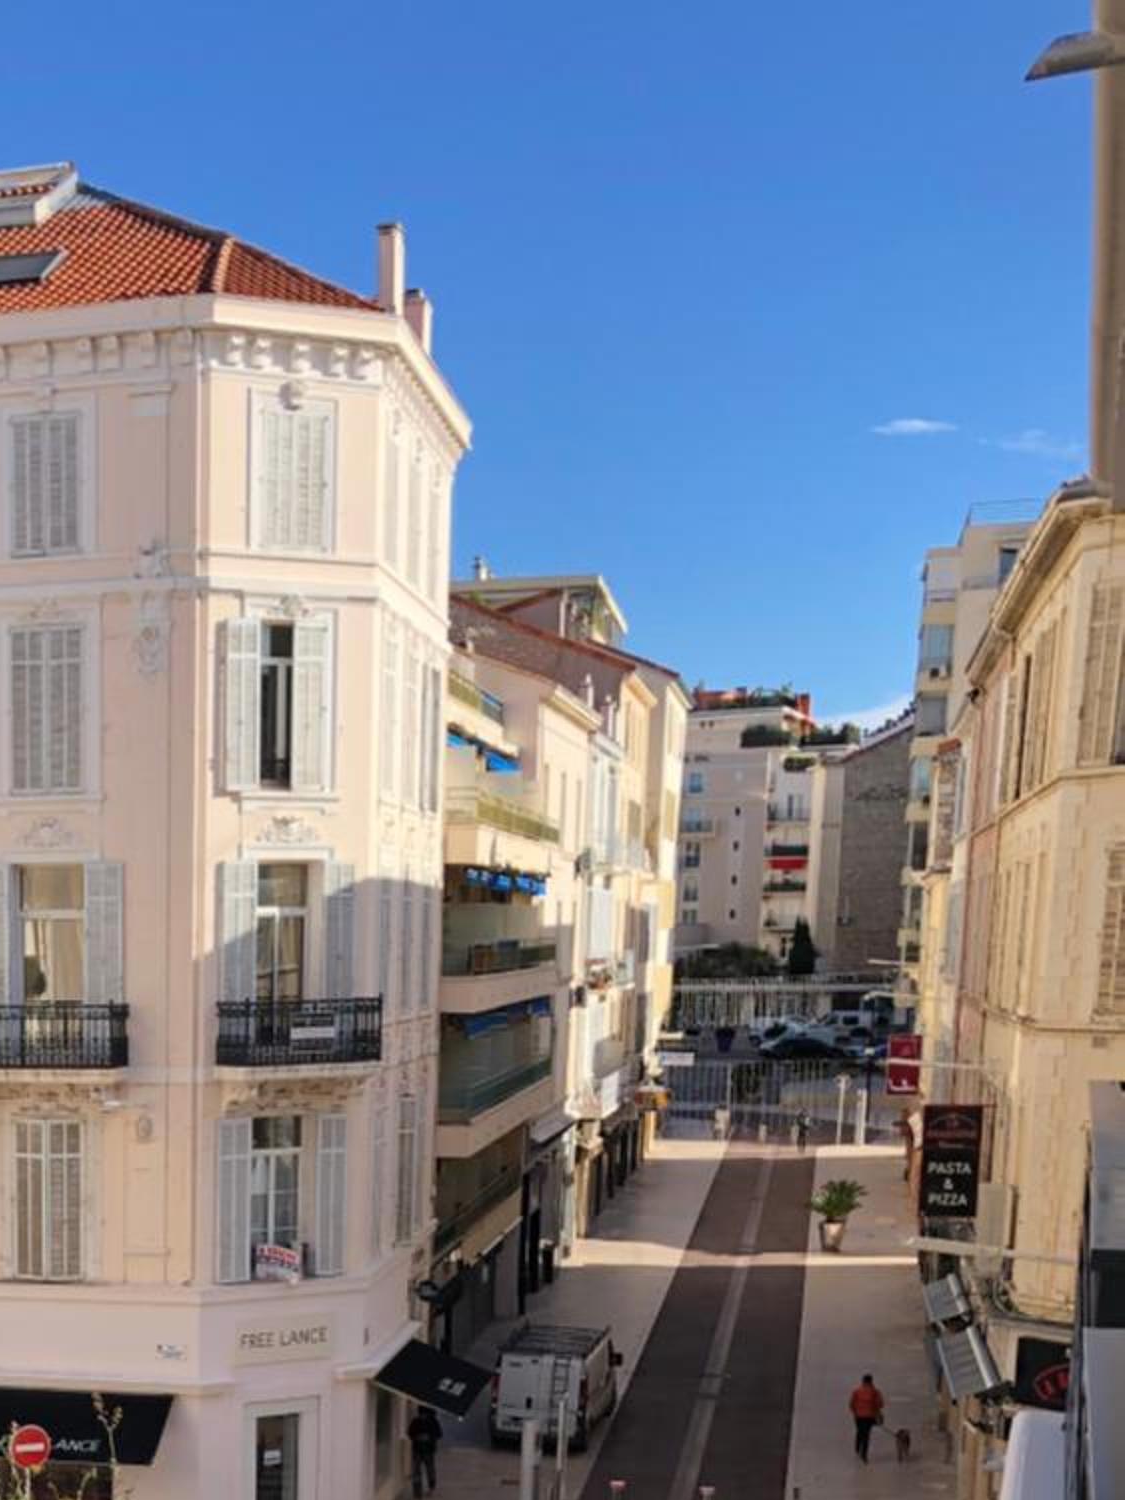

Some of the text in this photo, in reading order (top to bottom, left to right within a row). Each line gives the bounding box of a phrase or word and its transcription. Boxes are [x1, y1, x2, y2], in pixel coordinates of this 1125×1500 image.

[927, 1161, 971, 1174] PASTA
[943, 1178, 954, 1190] &
[928, 1193, 968, 1206] PIZZA
[241, 1327, 328, 1349] FREE LANCE
[55, 1438, 102, 1451] ANCE
